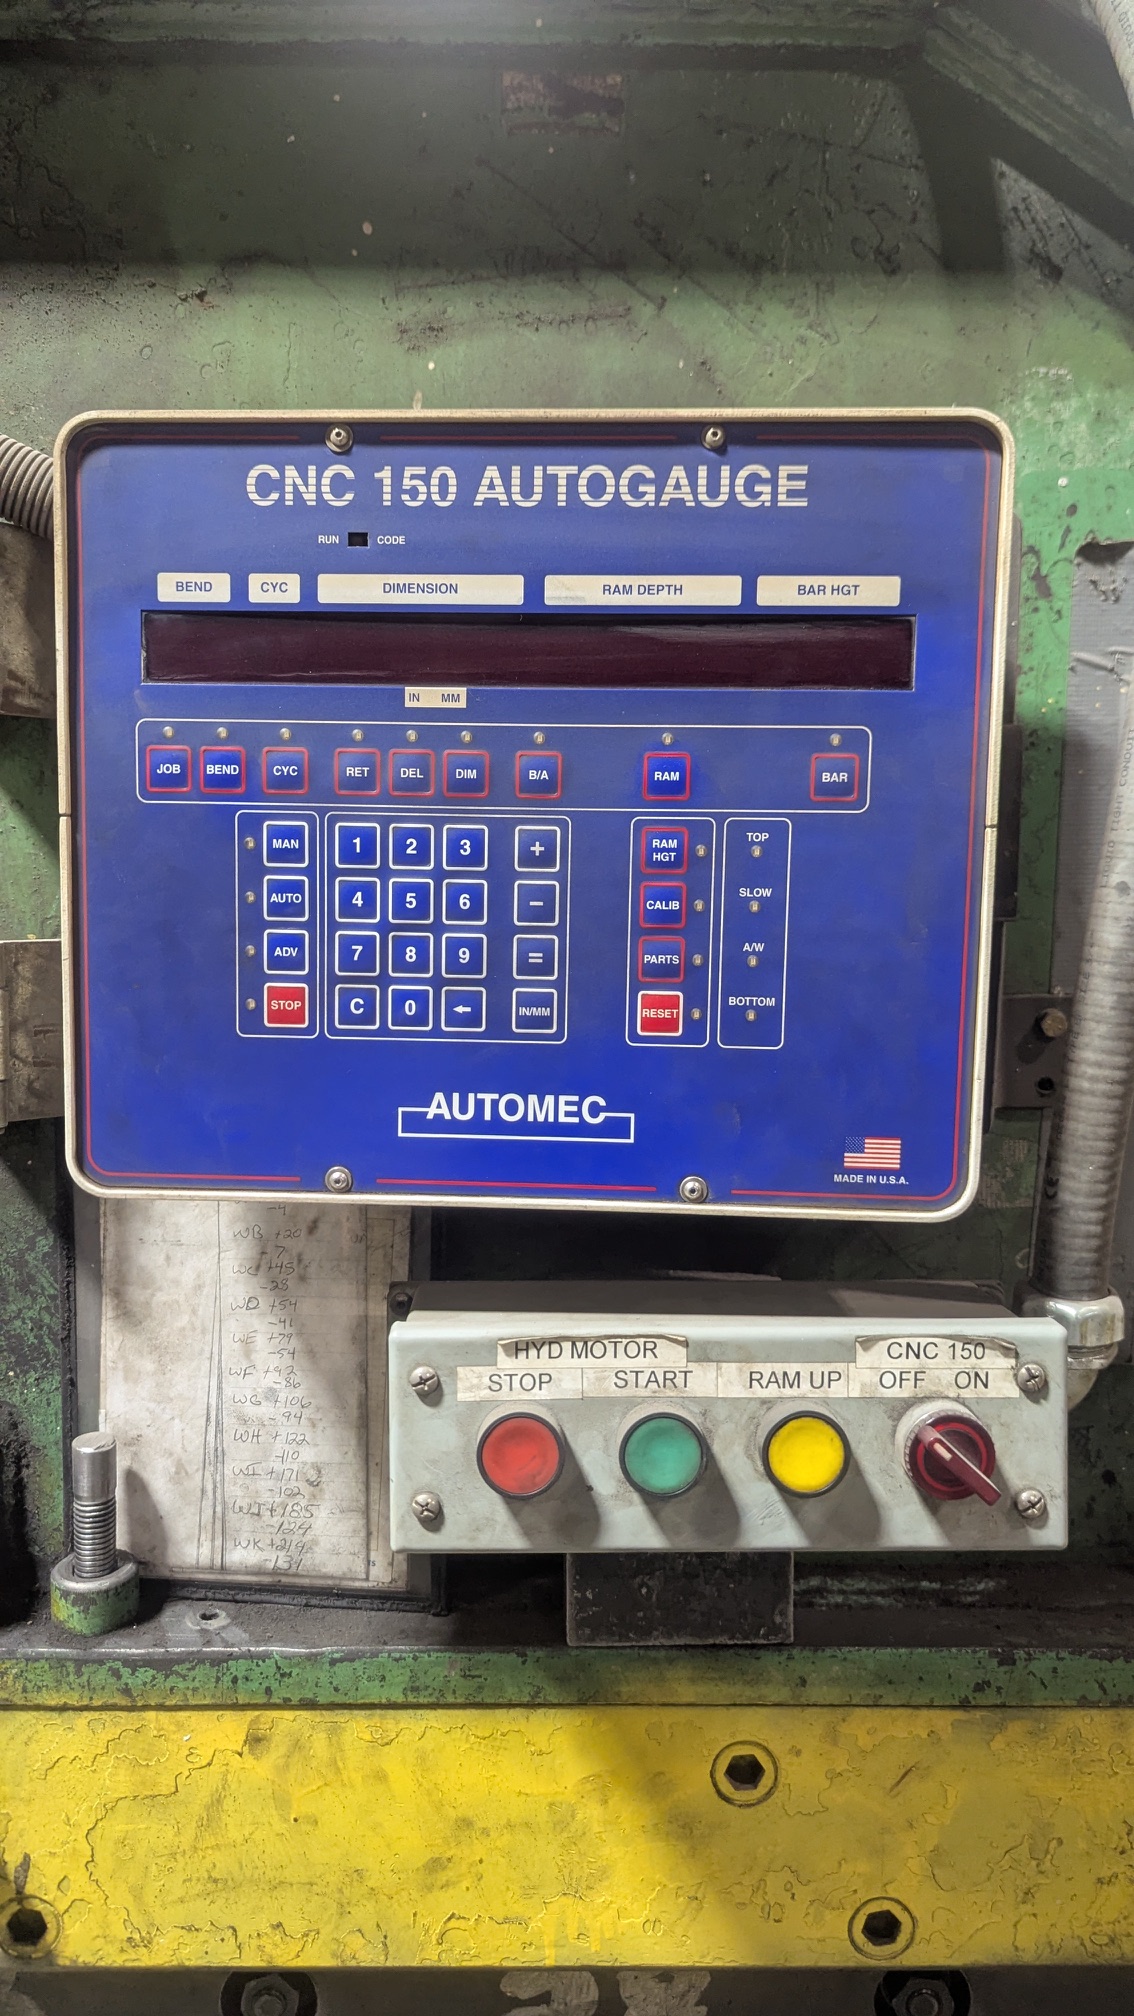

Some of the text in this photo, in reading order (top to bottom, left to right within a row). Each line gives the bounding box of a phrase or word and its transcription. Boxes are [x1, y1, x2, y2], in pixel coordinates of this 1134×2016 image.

[246, 463, 809, 508] CNC 150 AUTOGAUGE
[318, 534, 339, 544] RUN
[377, 535, 406, 545] CODE
[175, 581, 213, 593] BEND
[260, 581, 288, 593] CYC
[382, 582, 459, 594] DIMENSION
[602, 583, 683, 596] RAM DEPTH
[797, 584, 860, 596] BAR HGT
[408, 692, 420, 703] IN
[441, 692, 461, 703] MM
[156, 763, 181, 775] JOB
[206, 764, 239, 776] BEND
[272, 765, 298, 777] CYC
[346, 767, 369, 778] RET
[400, 768, 424, 779] DEL
[455, 769, 477, 780] DIM
[528, 770, 549, 781] B/A
[654, 771, 680, 782] RAM
[821, 772, 848, 783] BAR
[1111, 794, 1124, 831] TIGHT
[272, 838, 299, 849] MAN
[652, 838, 678, 849] RAM
[746, 832, 769, 843] TOP
[352, 837, 362, 853] 1
[405, 838, 417, 855] 2
[459, 839, 471, 856] 3
[652, 852, 676, 863] HGT
[270, 892, 302, 904] AUTO
[738, 888, 772, 898] SLOW
[352, 891, 363, 908] 4
[405, 893, 417, 909] 5
[459, 893, 471, 910] 6
[646, 900, 680, 911] CALIB
[274, 946, 298, 958] ADV
[351, 945, 363, 961] 7
[742, 942, 765, 953] A/W
[405, 946, 417, 963] 8
[458, 947, 470, 964] 9
[643, 954, 680, 966] PARTS
[270, 999, 302, 1011] STOP
[350, 998, 365, 1014] C
[404, 999, 416, 1016] 0
[728, 996, 775, 1007] BOTTOM
[518, 1006, 550, 1018] IN/MM
[642, 1008, 678, 1019] RESET
[426, 1091, 607, 1125] AUTOMEC
[833, 1174, 909, 1185] MADE IN U.S.A.
[233, 1224, 264, 1239] WB
[232, 1259, 296, 1276] WC +45
[260, 1279, 289, 1292] -28
[269, 1298, 298, 1314] +54
[233, 1330, 258, 1344] WE
[267, 1347, 296, 1360] -54
[514, 1339, 658, 1360] HYD MOTOR
[886, 1341, 986, 1361] CNC 150
[229, 1366, 255, 1380] WF
[273, 1377, 302, 1388] -86
[487, 1372, 553, 1394] STOP
[613, 1369, 693, 1390] START
[748, 1370, 842, 1391] RAM UP
[879, 1369, 926, 1390] OFF
[954, 1369, 989, 1390] ON
[273, 1393, 312, 1408] +106
[233, 1429, 261, 1444] WH
[232, 1461, 263, 1476] WI
[233, 1537, 264, 1553] WK
